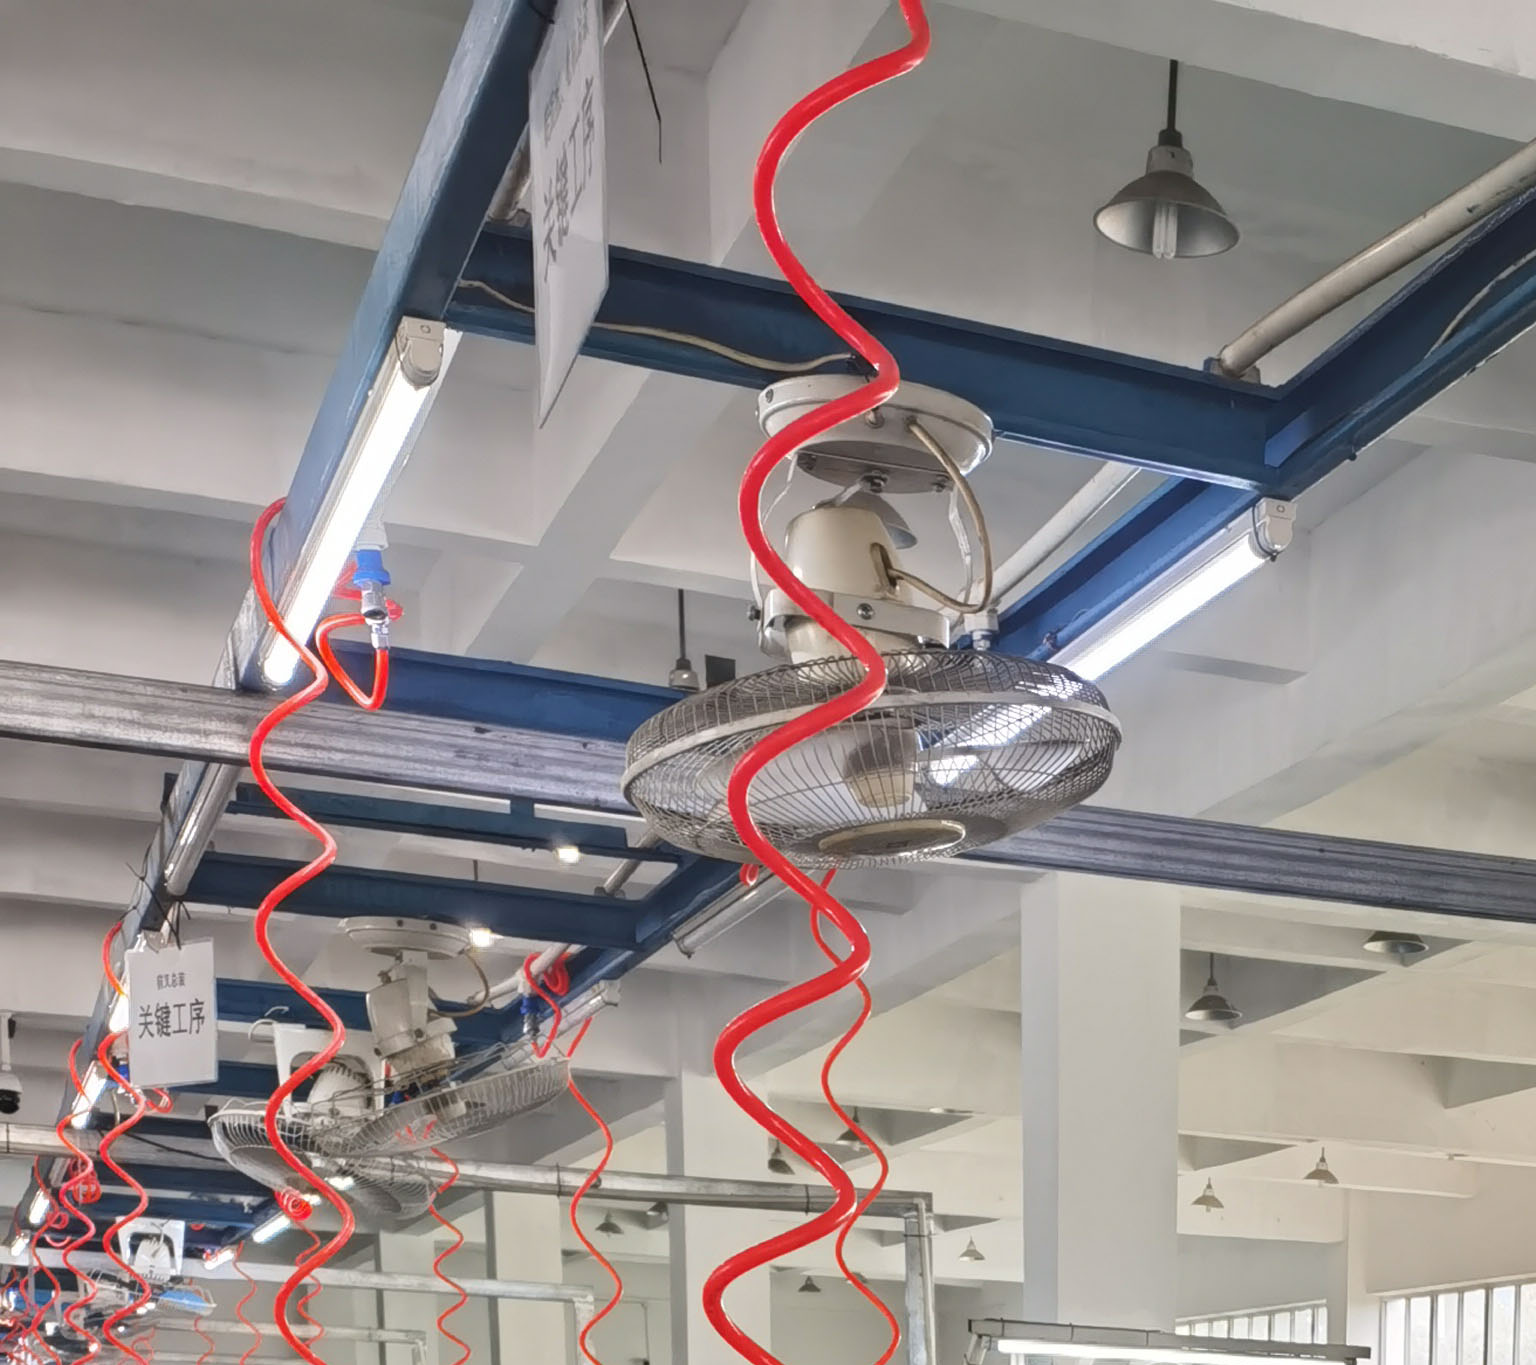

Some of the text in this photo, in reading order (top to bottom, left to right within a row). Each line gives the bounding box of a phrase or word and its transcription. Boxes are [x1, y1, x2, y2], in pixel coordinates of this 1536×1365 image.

[543, 75, 595, 284] 关键工序
[138, 998, 206, 1039] 关键工序
